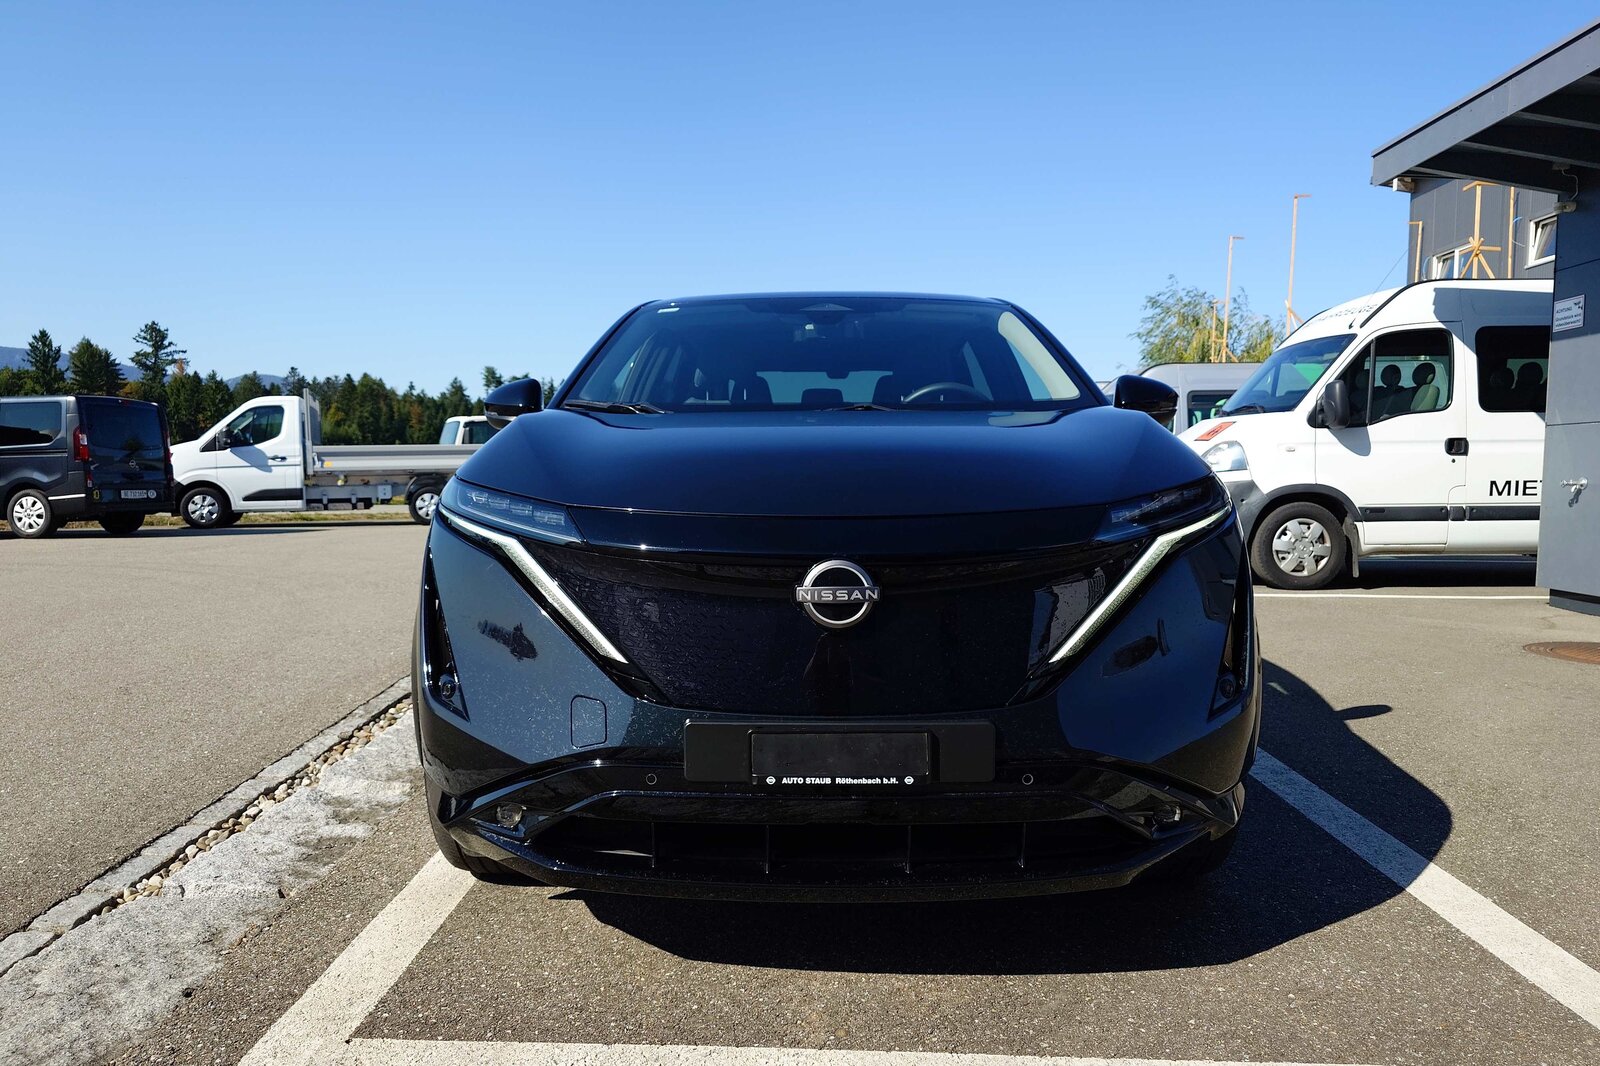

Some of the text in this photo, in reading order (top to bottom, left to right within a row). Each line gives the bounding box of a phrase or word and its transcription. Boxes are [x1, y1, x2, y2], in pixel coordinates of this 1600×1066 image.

[1489, 480, 1543, 497] MIE
[798, 589, 879, 601] NISSAN
[835, 776, 882, 785] Röthenbach
[882, 776, 899, 785] b.H.
